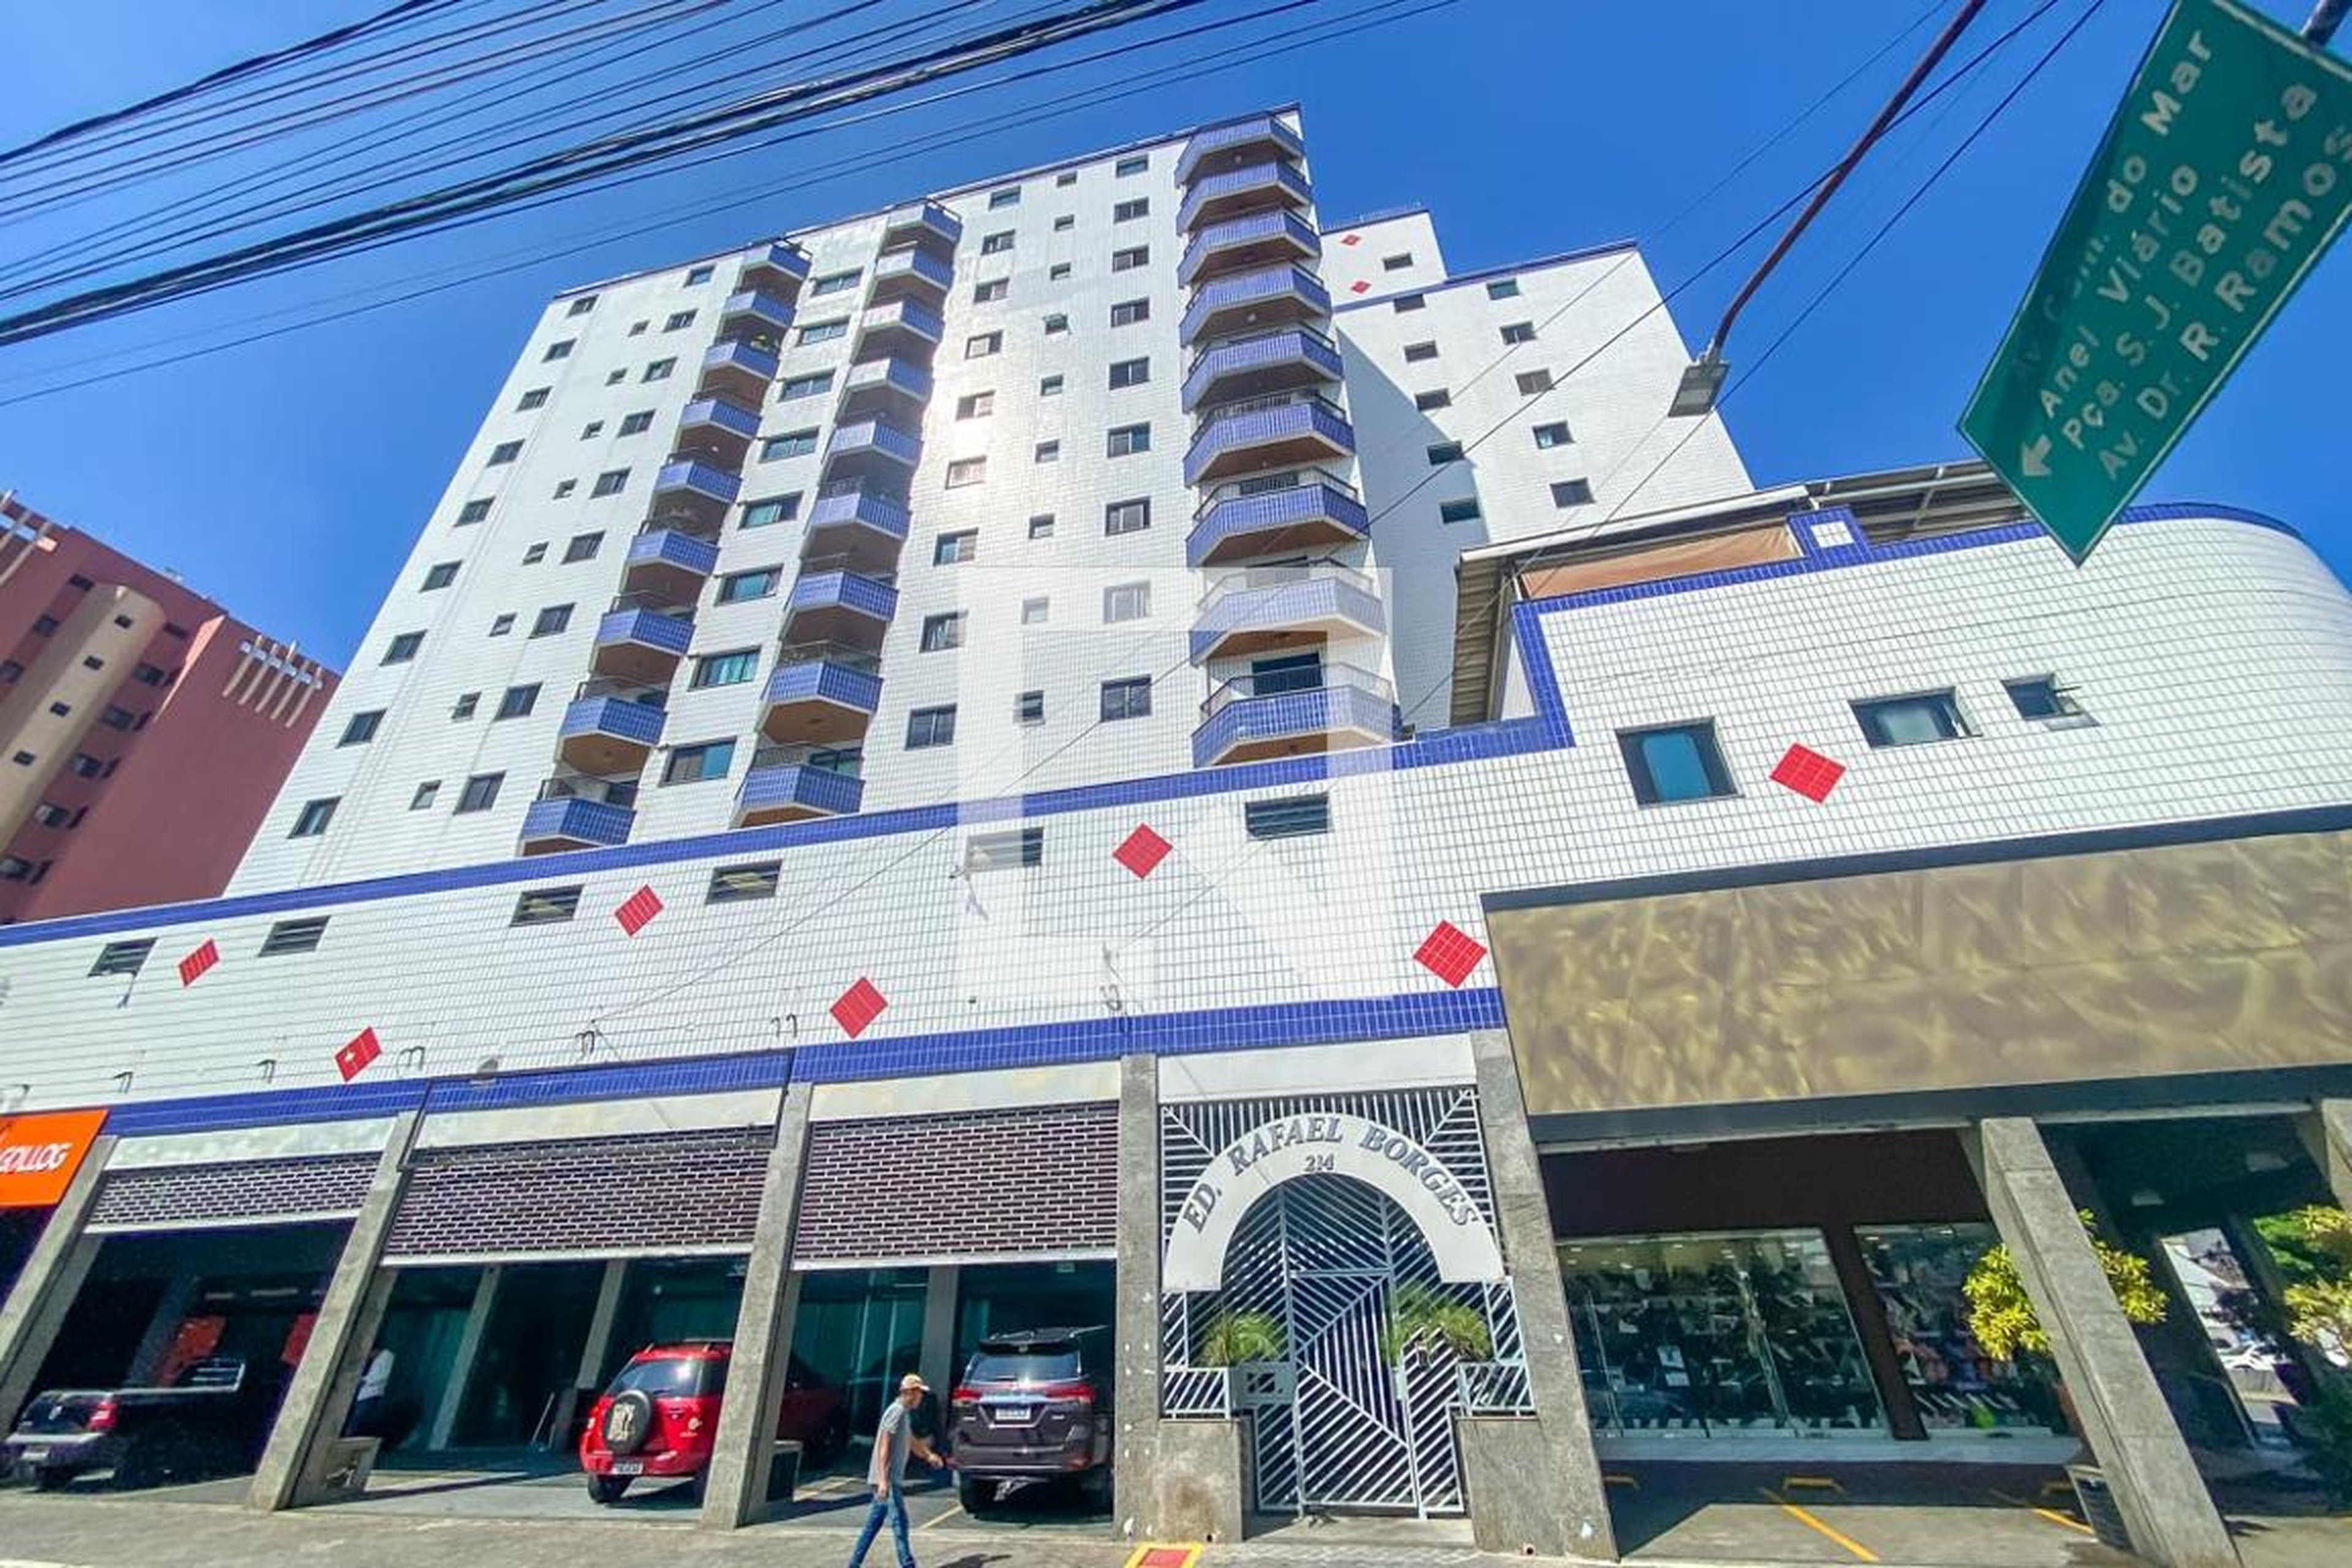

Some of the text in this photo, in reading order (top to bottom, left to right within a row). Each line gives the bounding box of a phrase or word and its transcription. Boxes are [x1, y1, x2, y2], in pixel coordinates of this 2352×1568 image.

[2107, 155, 2147, 213] do
[2140, 29, 2213, 136] Mar
[2116, 331, 2155, 366] S.
[2144, 294, 2182, 331] J.
[2169, 83, 2318, 288] Batista
[2040, 163, 2198, 420] Anel Viário
[2179, 320, 2230, 361] R.
[2213, 124, 2352, 313] Ramos
[1182, 1117, 1480, 1234] ED. RAFAEL BORGES
